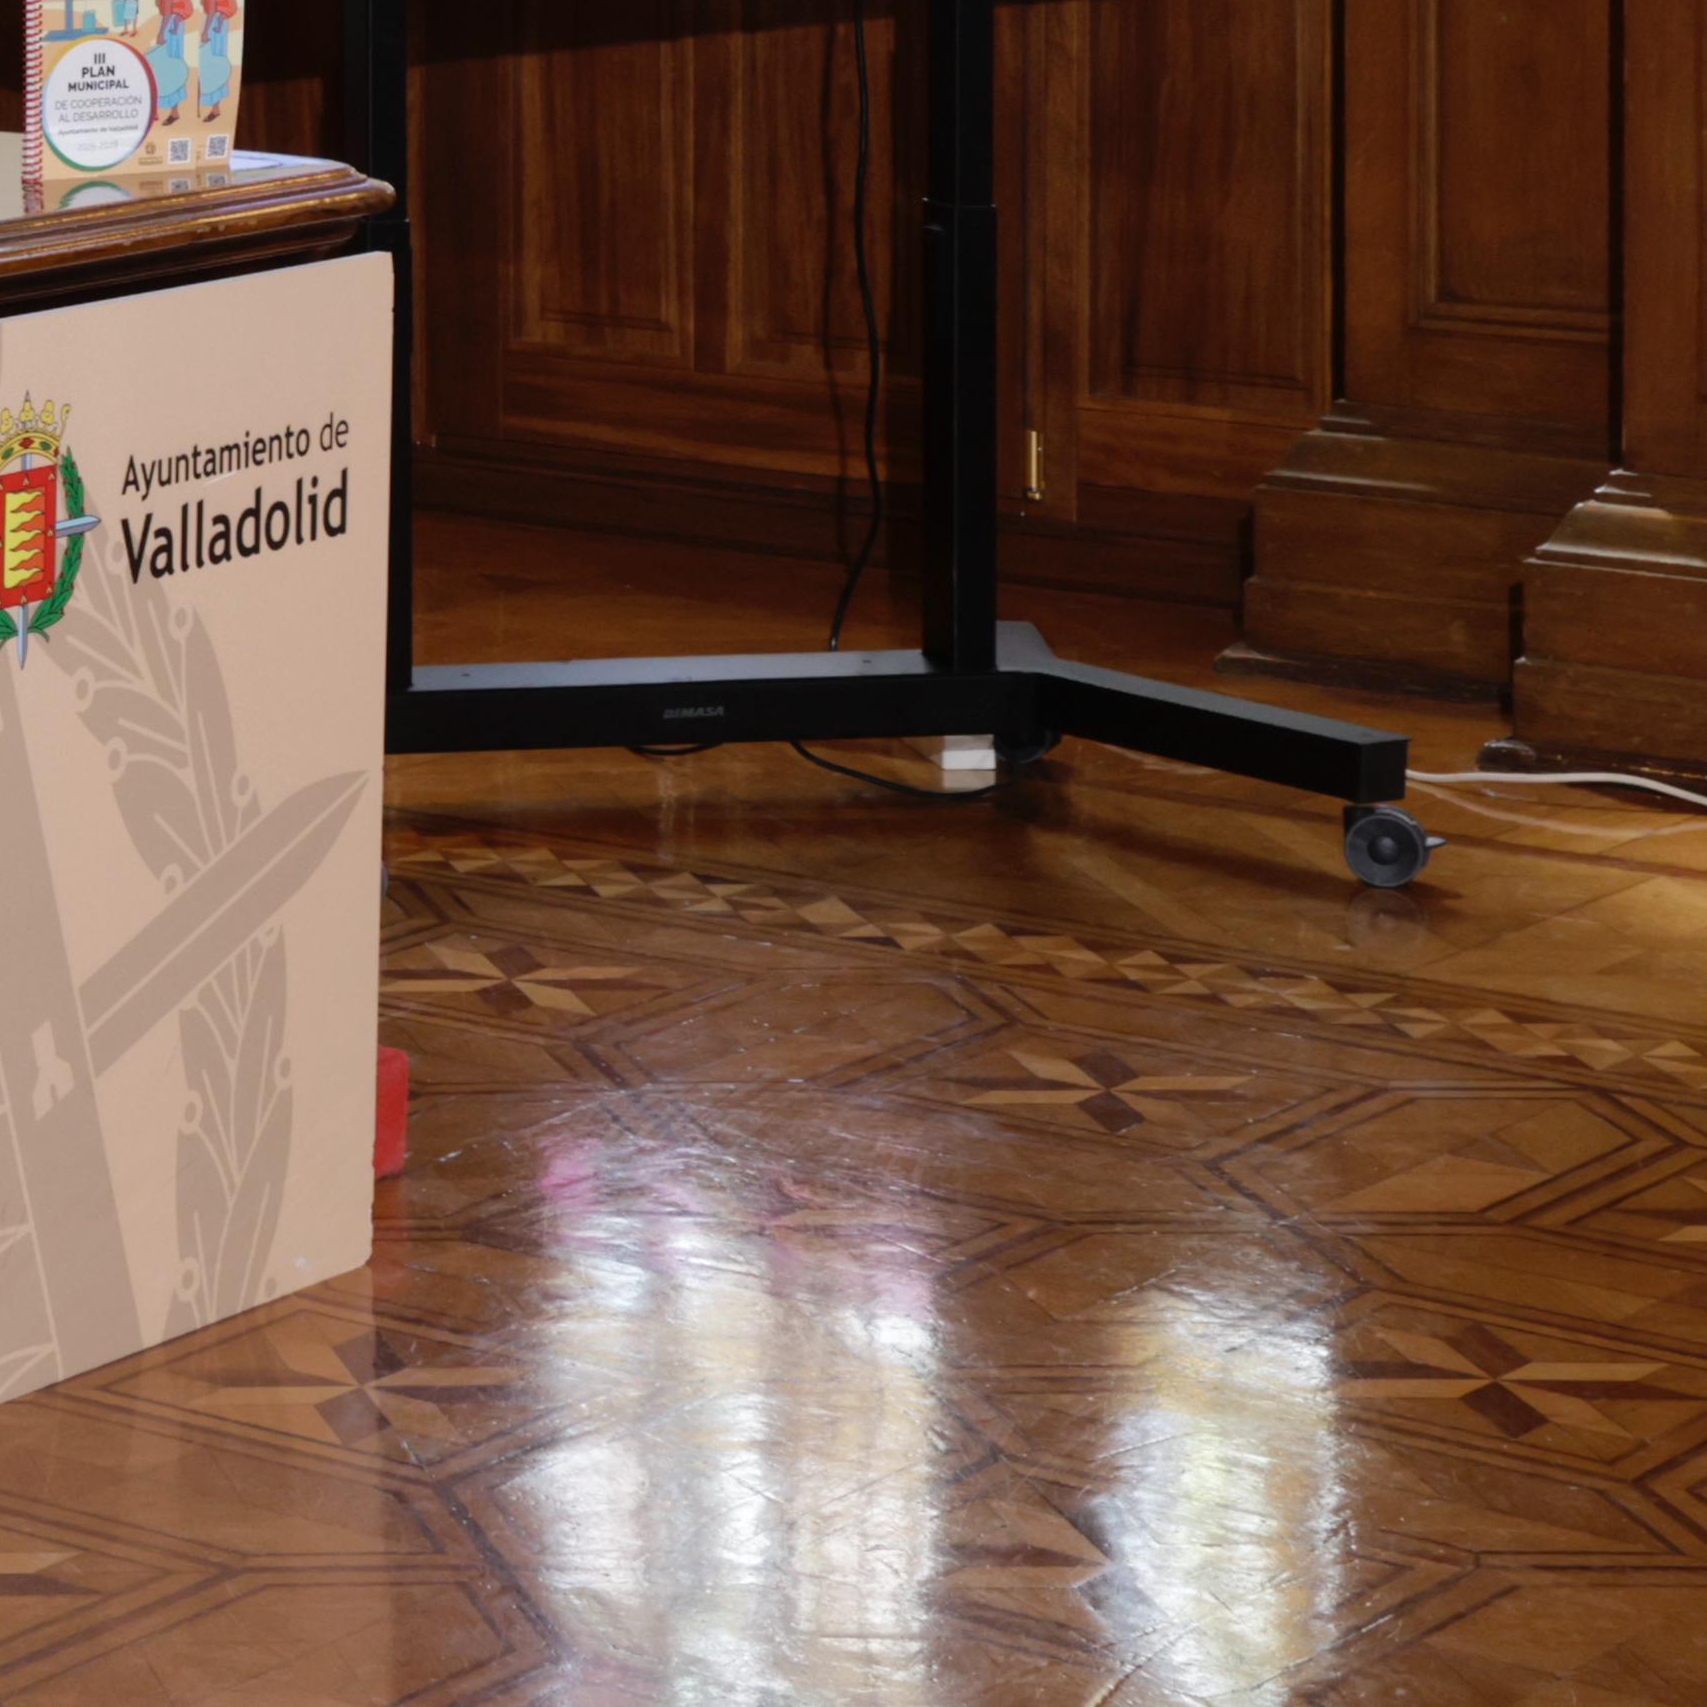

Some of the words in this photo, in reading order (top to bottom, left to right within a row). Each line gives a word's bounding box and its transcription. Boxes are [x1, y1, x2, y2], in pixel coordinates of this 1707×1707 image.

[94, 53, 105, 64] III
[82, 66, 115, 78] PLAN
[68, 79, 129, 91] MUNICIPAL
[55, 100, 68, 110] DE
[71, 95, 142, 109] COOPERACIÓN
[59, 113, 70, 123] AL
[74, 109, 139, 122] DESARROLLO
[122, 426, 309, 500] Ayuntamiento
[320, 412, 348, 451] de
[122, 468, 348, 584] Valladolid
